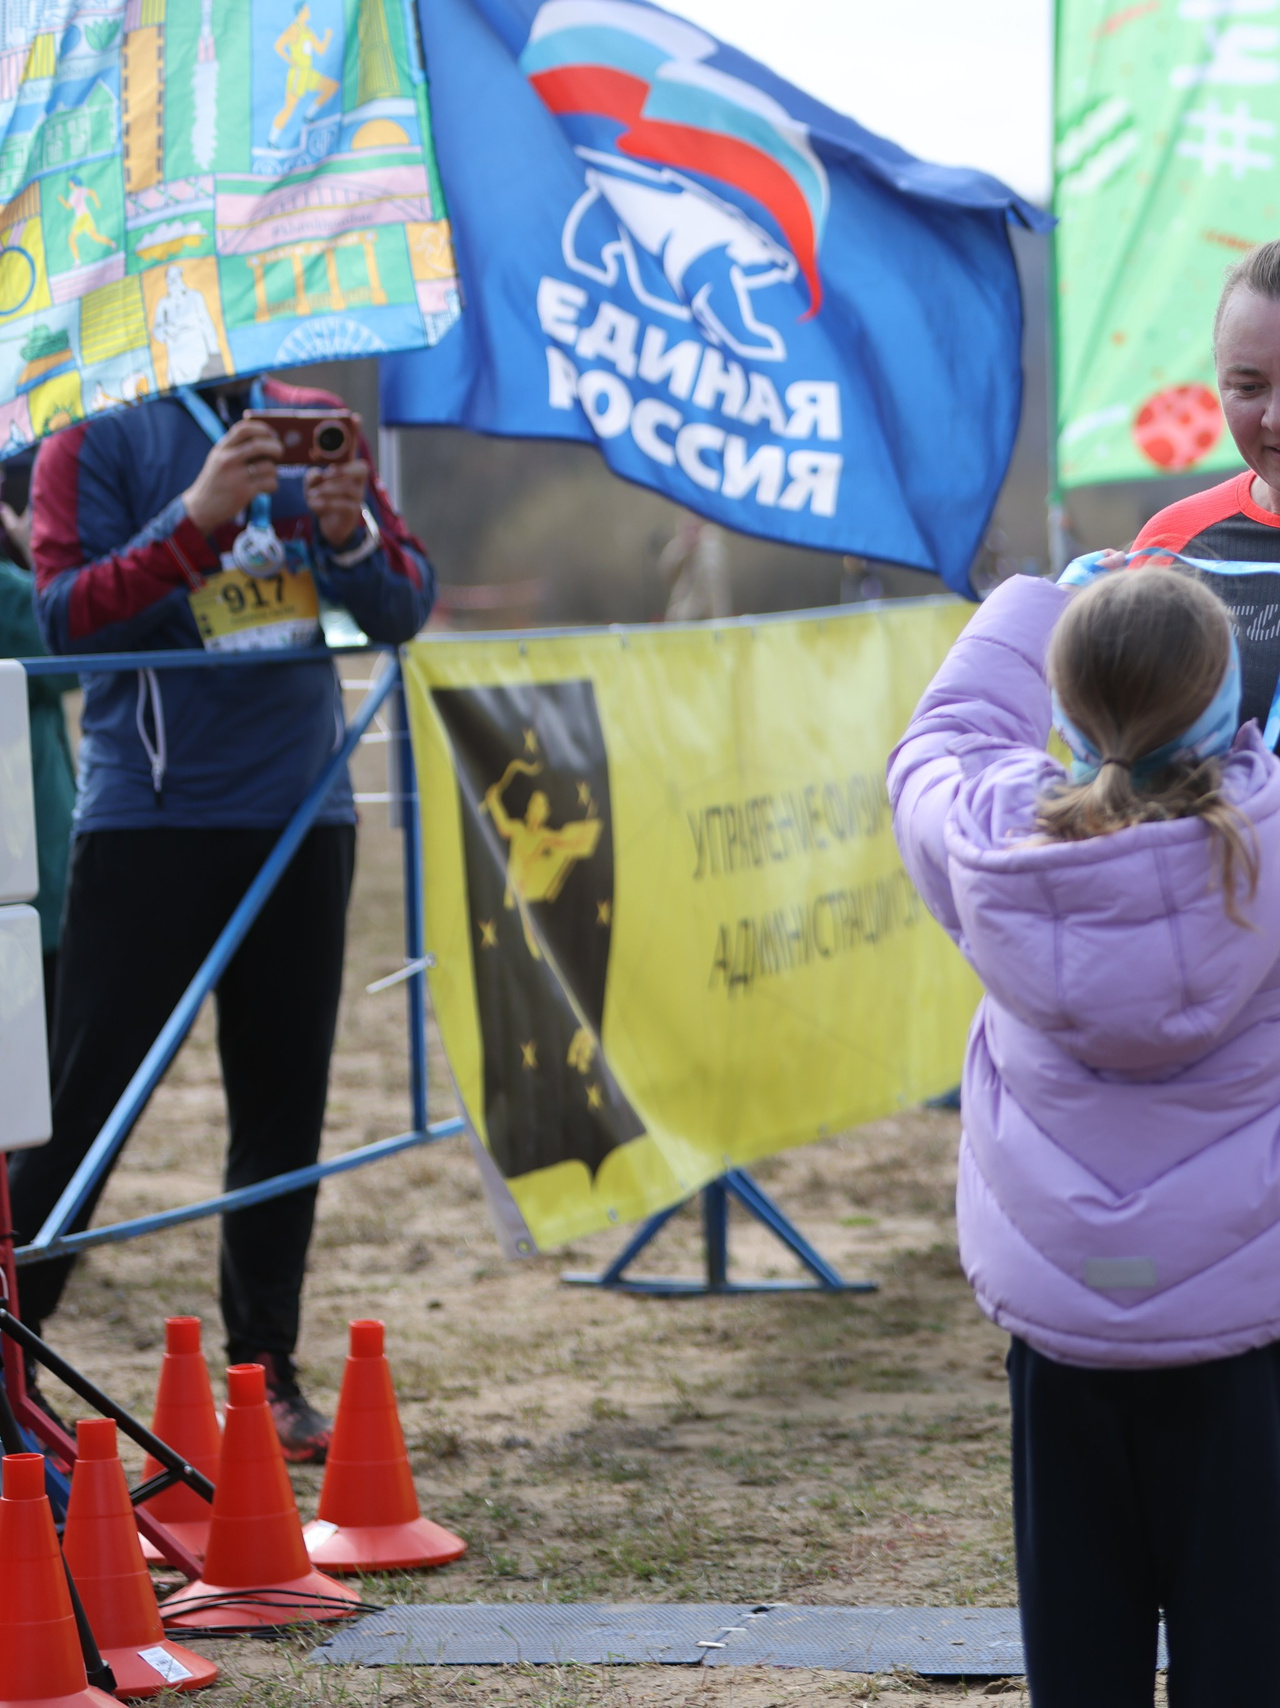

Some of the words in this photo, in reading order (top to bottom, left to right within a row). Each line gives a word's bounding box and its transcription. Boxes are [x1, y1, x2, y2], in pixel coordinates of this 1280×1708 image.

[536, 275, 842, 440] ЕДИНАЯ
[545, 344, 843, 517] РОССИЯ
[222, 573, 284, 613] 917
